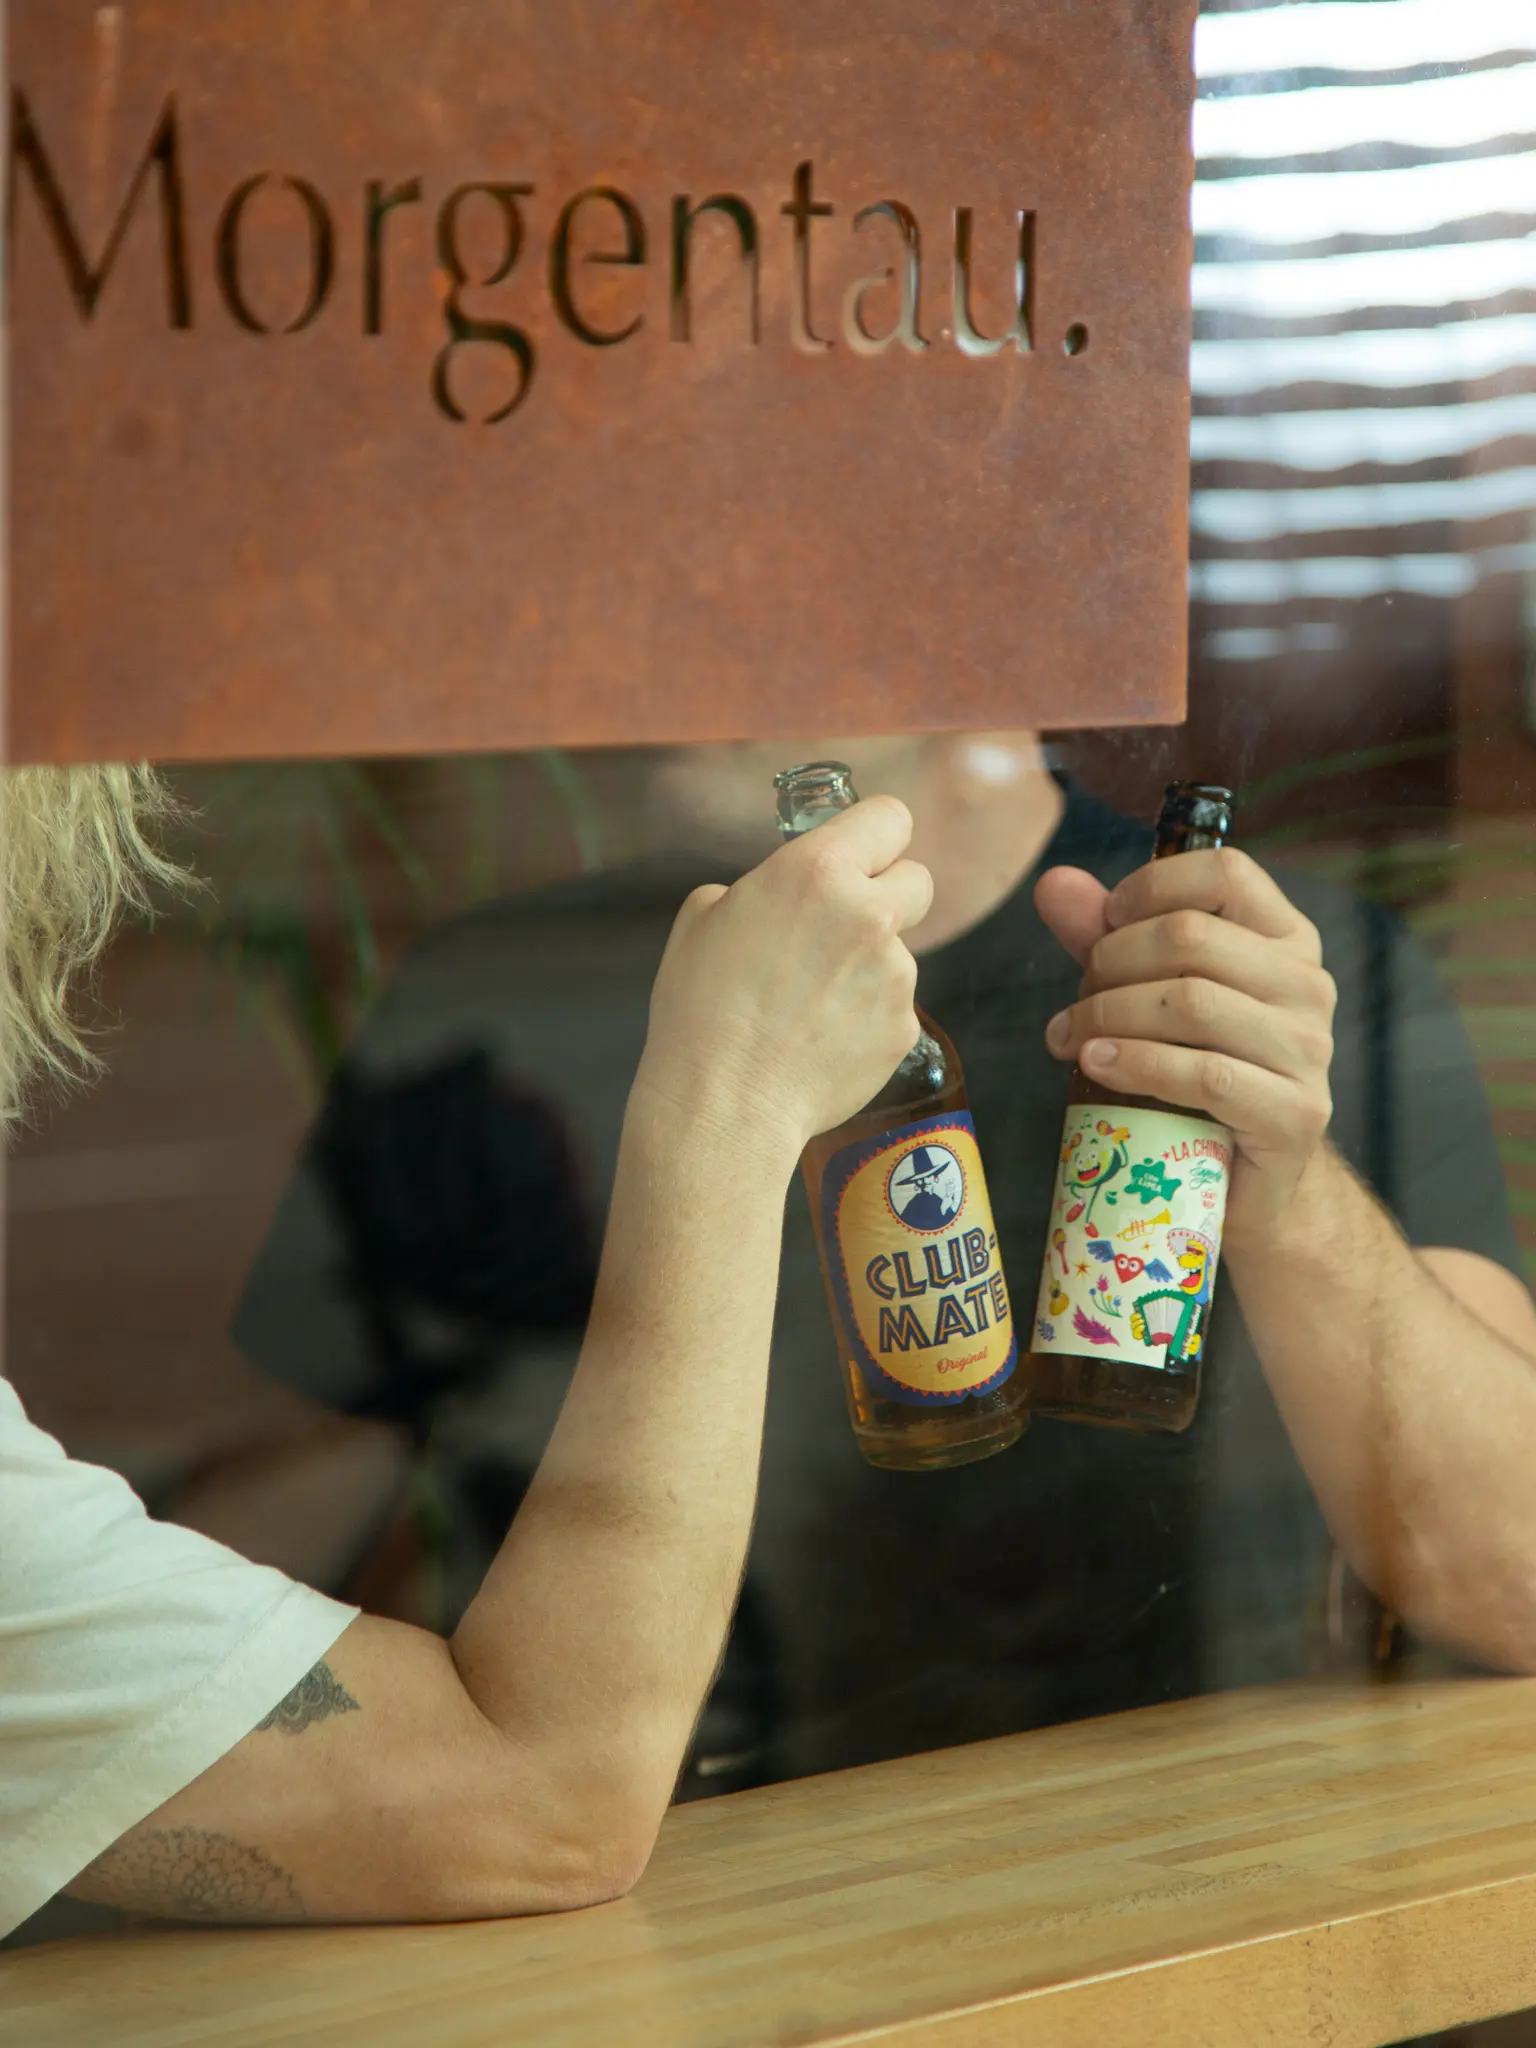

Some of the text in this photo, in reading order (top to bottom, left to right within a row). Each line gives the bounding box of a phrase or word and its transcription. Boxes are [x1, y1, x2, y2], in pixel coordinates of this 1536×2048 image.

[8, 84, 1090, 425] Morgentau.
[1171, 1141, 1190, 1162] LA
[866, 1227, 997, 1301] CLUB-
[879, 1270, 1008, 1353] MATE
[936, 1346, 989, 1374] Original
